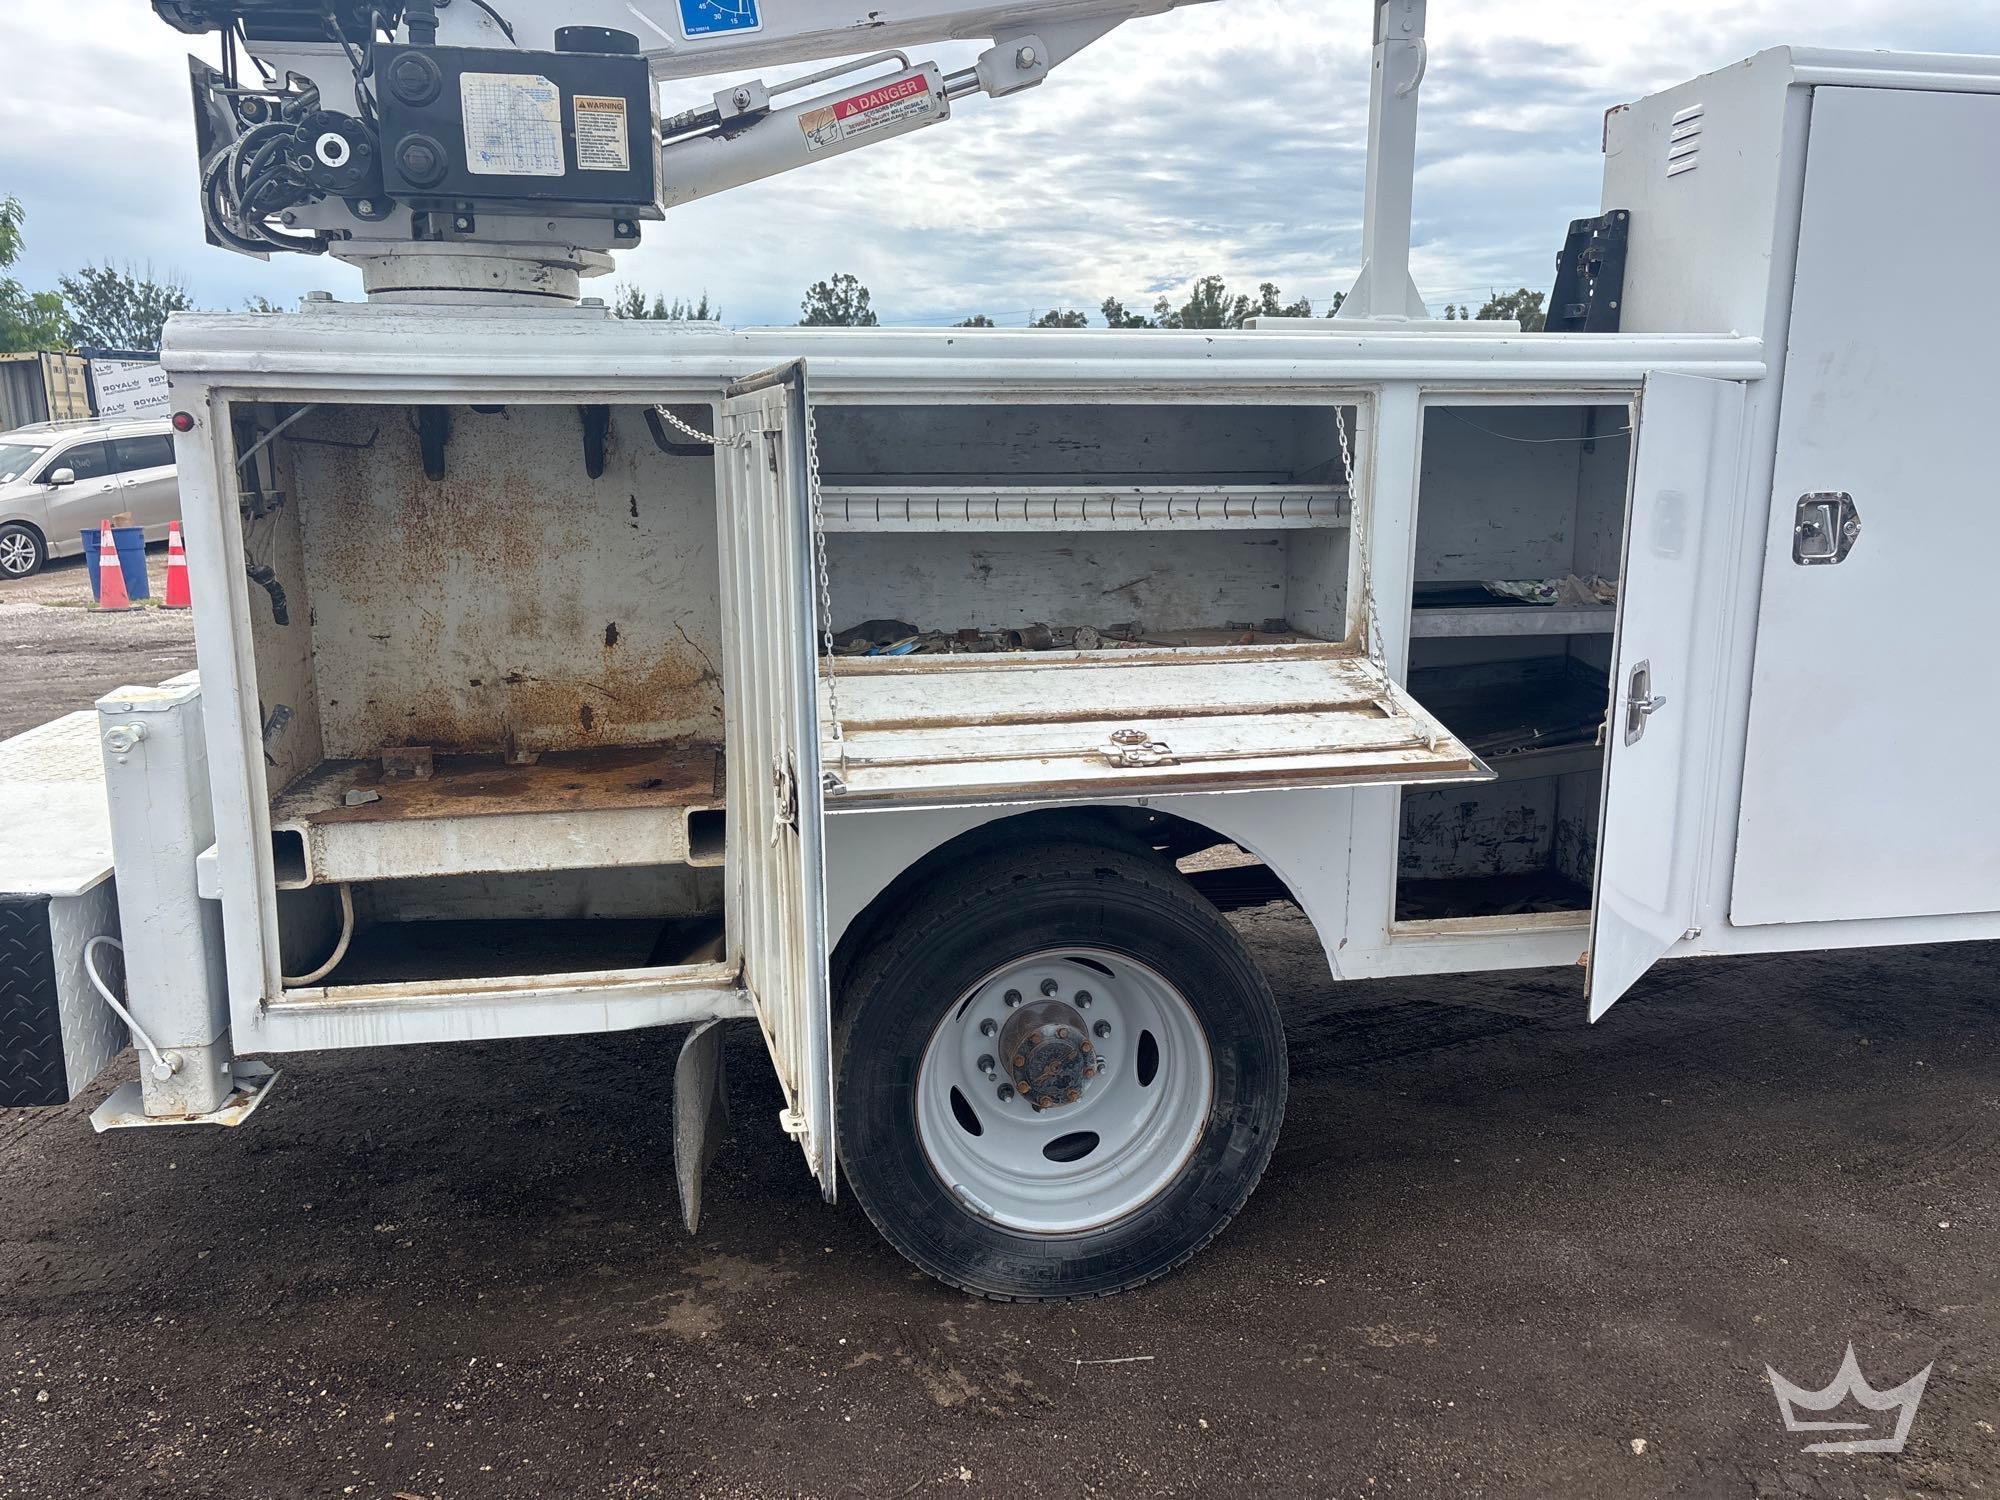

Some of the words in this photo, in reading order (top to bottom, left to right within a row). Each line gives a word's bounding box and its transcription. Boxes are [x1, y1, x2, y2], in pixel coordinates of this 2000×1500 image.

[858, 81, 918, 109] DANGER
[586, 101, 624, 110] WARNING
[102, 381, 133, 393] ROYAL
[133, 395, 162, 406] ROYAL
